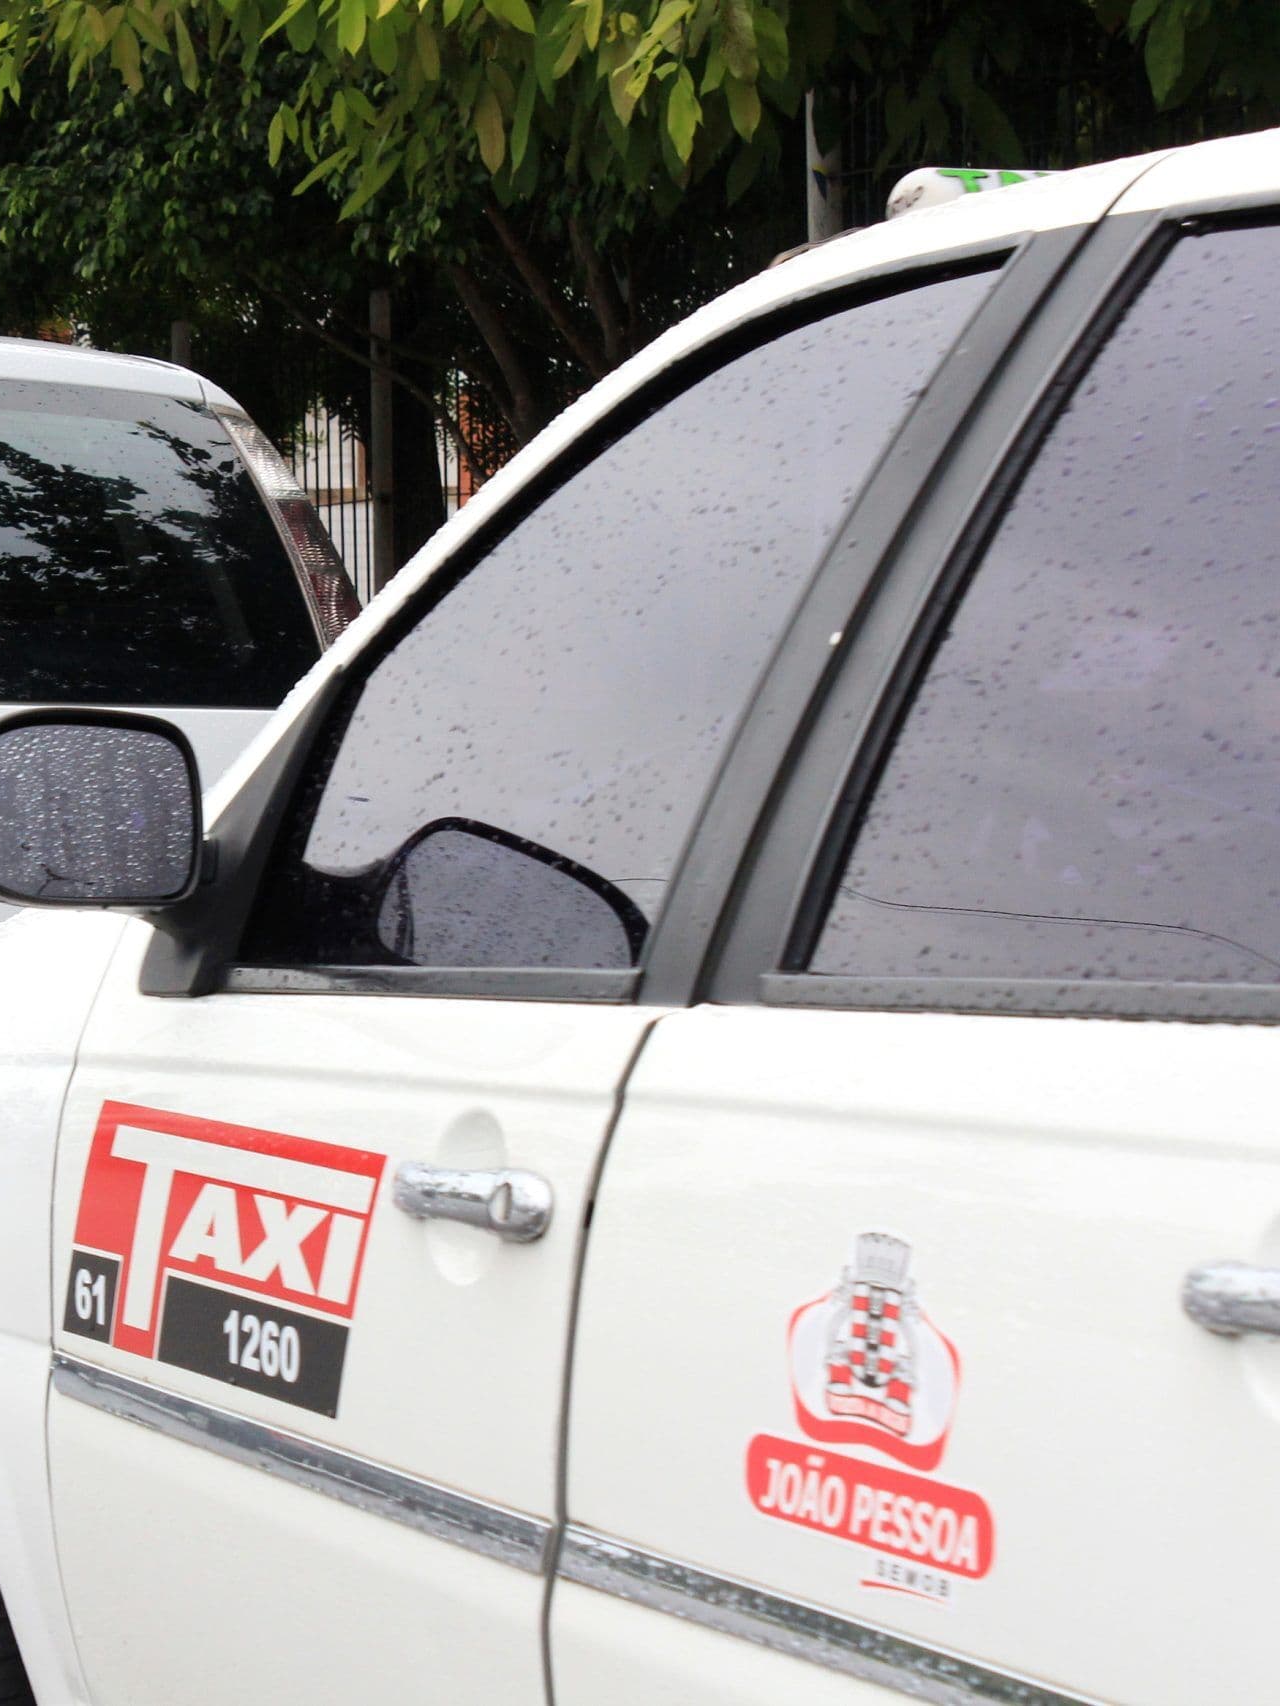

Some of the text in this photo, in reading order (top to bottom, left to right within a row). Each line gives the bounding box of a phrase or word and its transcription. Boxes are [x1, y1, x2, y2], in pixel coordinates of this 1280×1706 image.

[110, 1124, 377, 1332] TAXI
[74, 1268, 106, 1326] 61
[223, 1309, 300, 1384] 1260
[759, 1454, 980, 1572] JOÃO PESSOA
